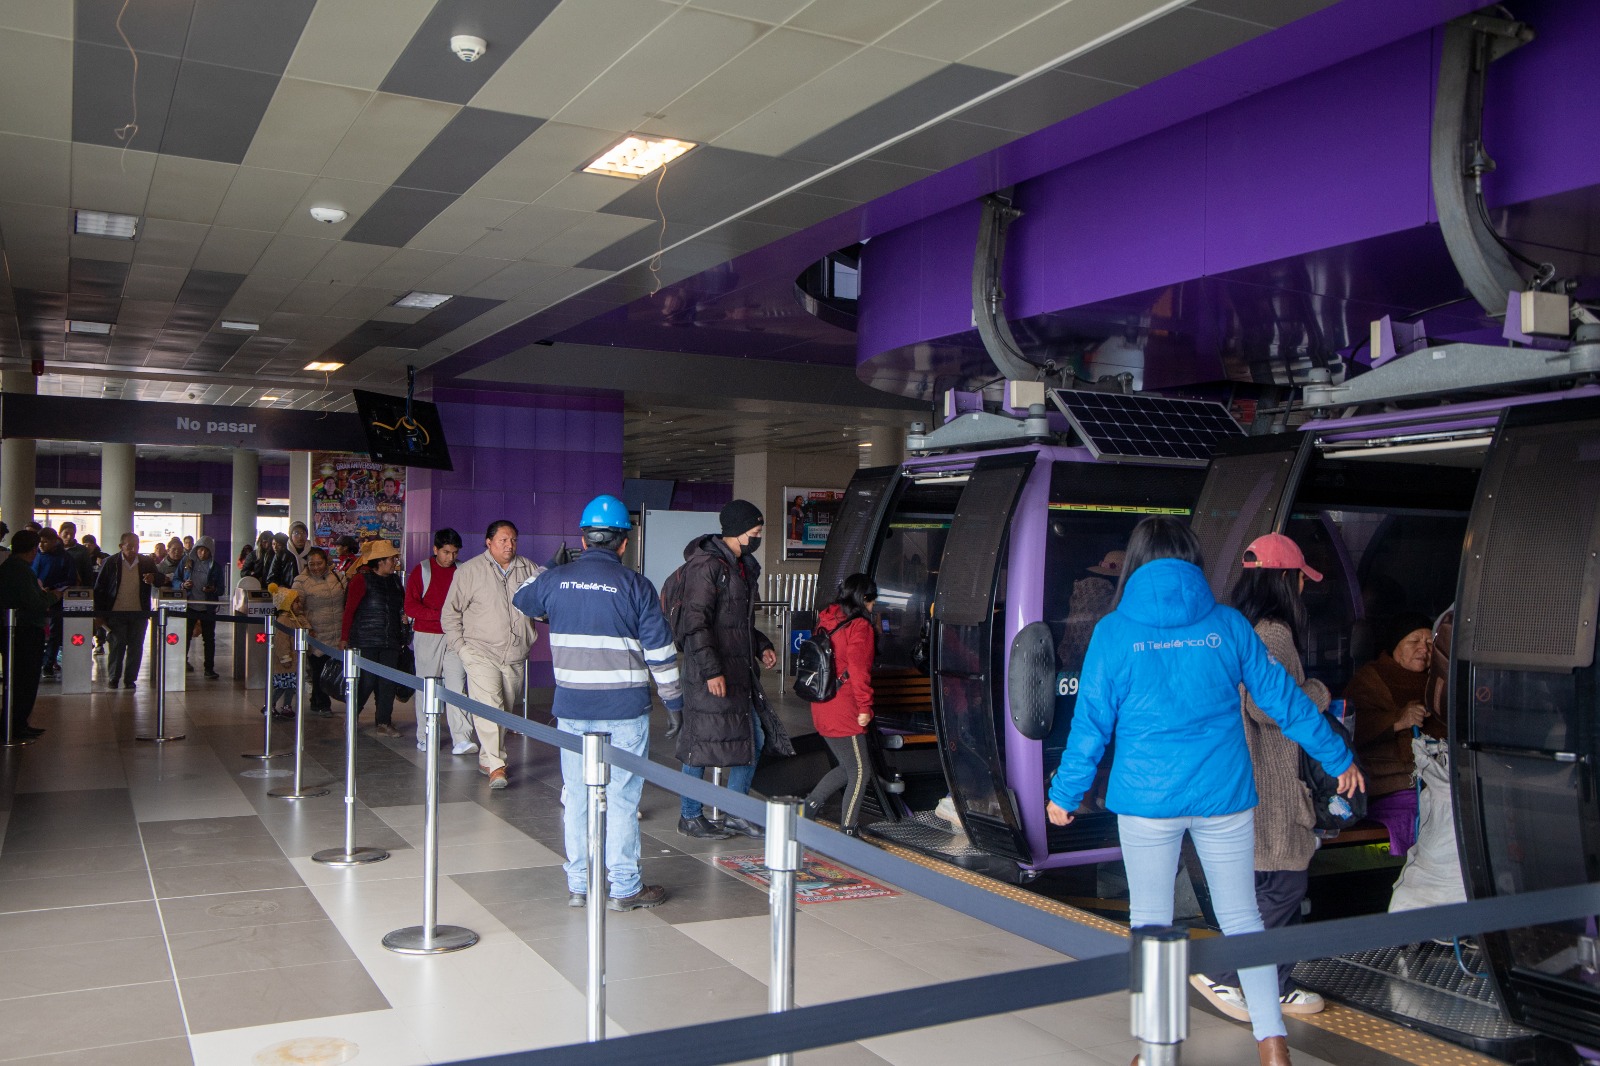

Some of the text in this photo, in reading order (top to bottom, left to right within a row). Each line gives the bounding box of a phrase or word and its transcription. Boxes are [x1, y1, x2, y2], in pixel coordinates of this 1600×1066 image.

[176, 416, 257, 434] No pasar
[571, 581, 618, 593] Teleférico
[1147, 638, 1205, 650] Teleférico
[1058, 677, 1079, 695] 69
